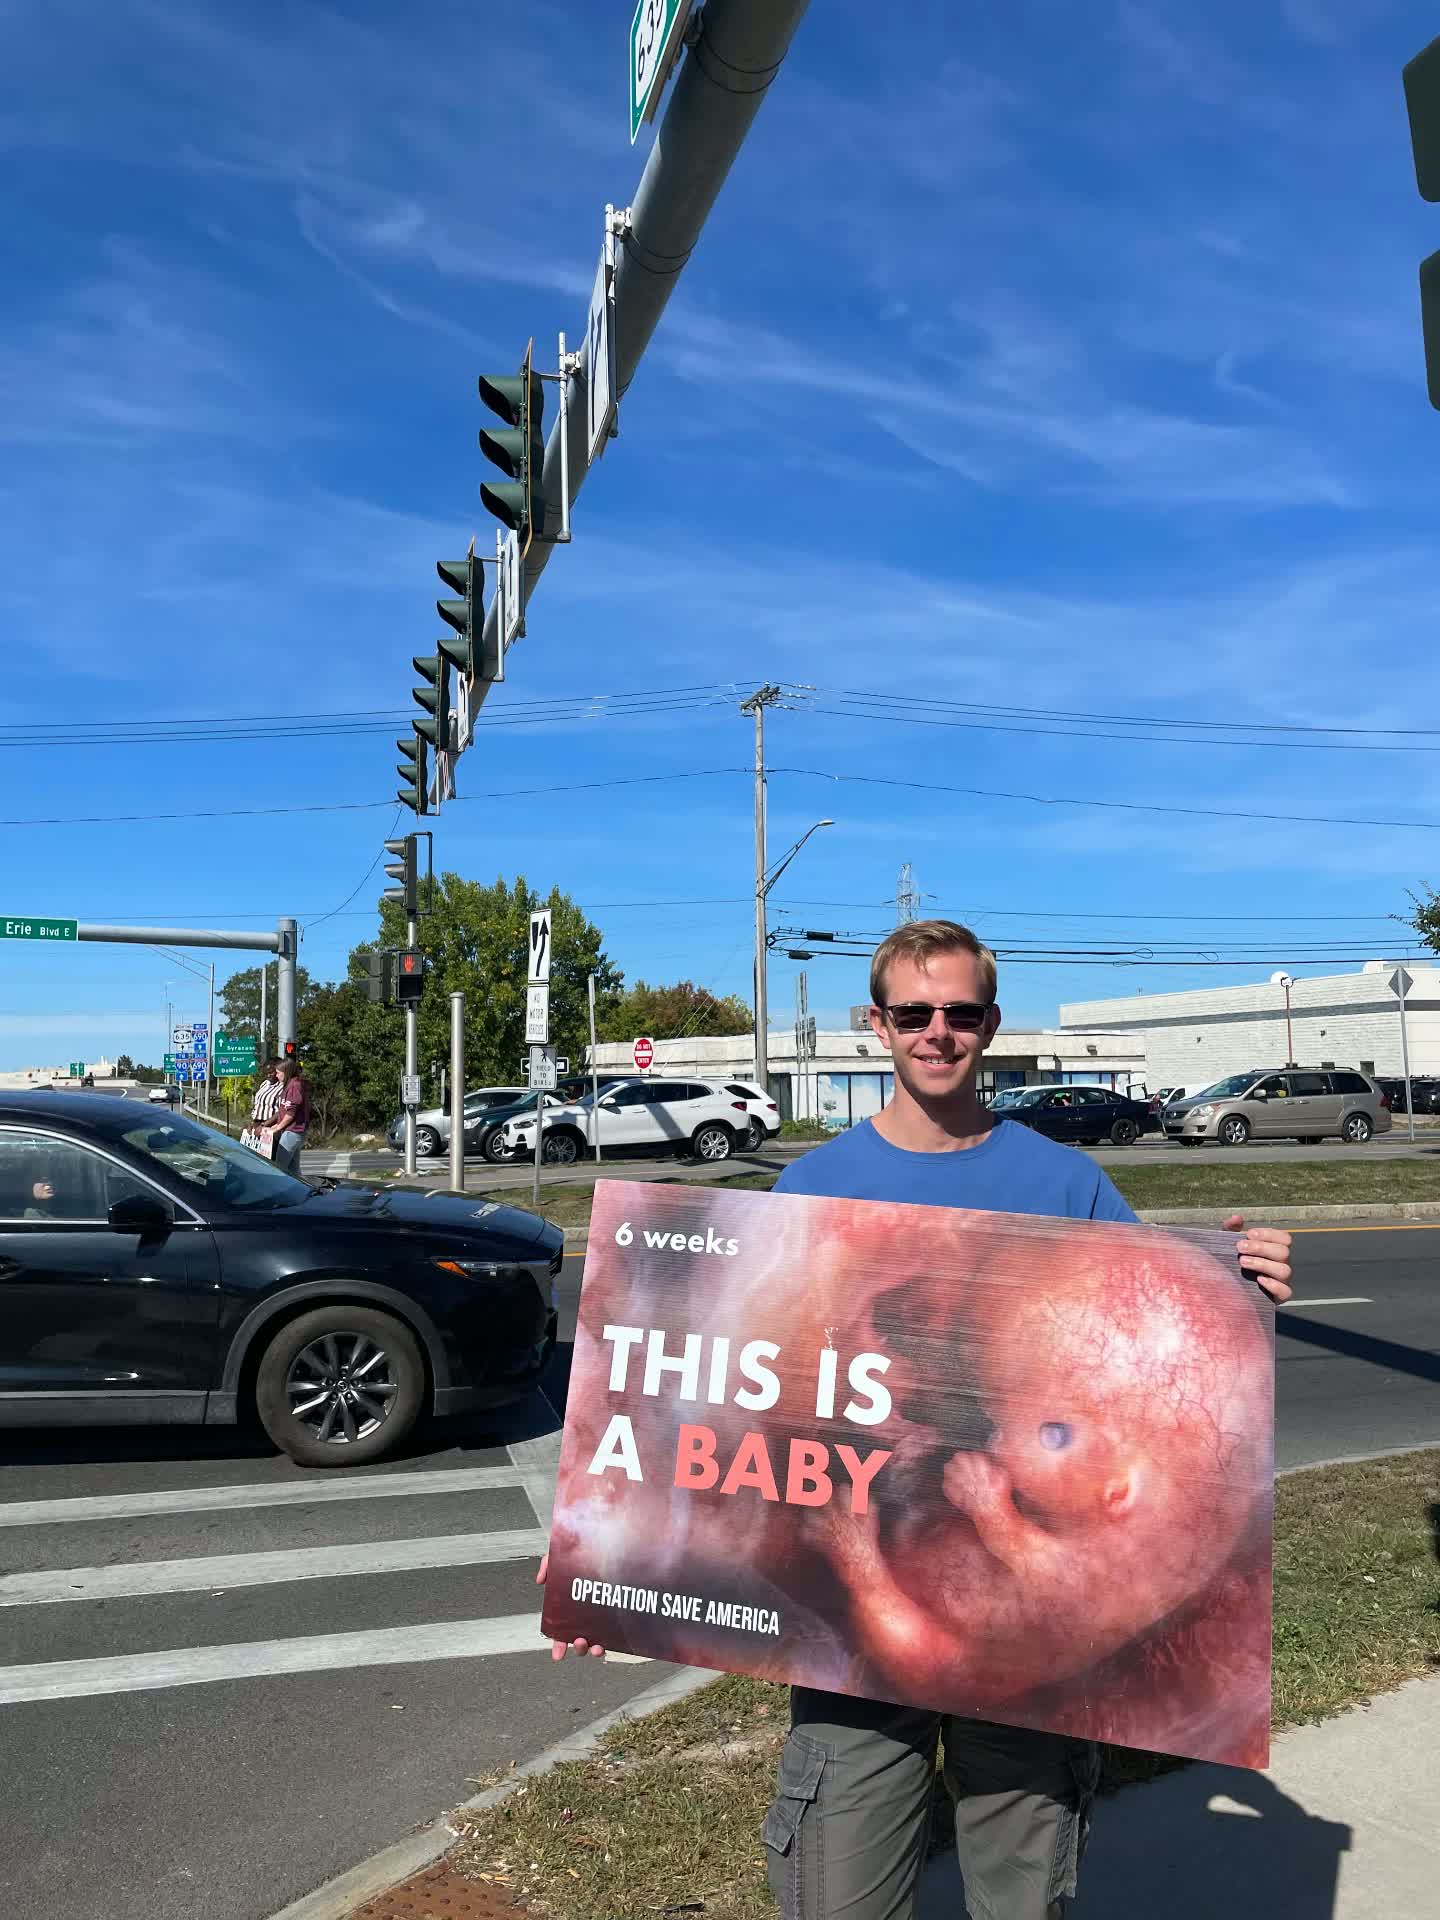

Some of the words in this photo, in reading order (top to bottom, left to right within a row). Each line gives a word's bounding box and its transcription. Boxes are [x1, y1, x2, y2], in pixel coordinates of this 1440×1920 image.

[6, 921, 32, 935] Erie
[40, 927, 59, 937] Blvd
[64, 928, 70, 937] E
[615, 1222, 633, 1247] 6
[643, 1228, 740, 1257] weeks
[602, 1324, 781, 1411] THIS
[815, 1349, 892, 1426] IS
[587, 1415, 645, 1482] A
[673, 1424, 893, 1517] BABY
[571, 1577, 658, 1614] OPERATION
[661, 1592, 703, 1622] SAVE
[704, 1600, 779, 1636] AMERICA
